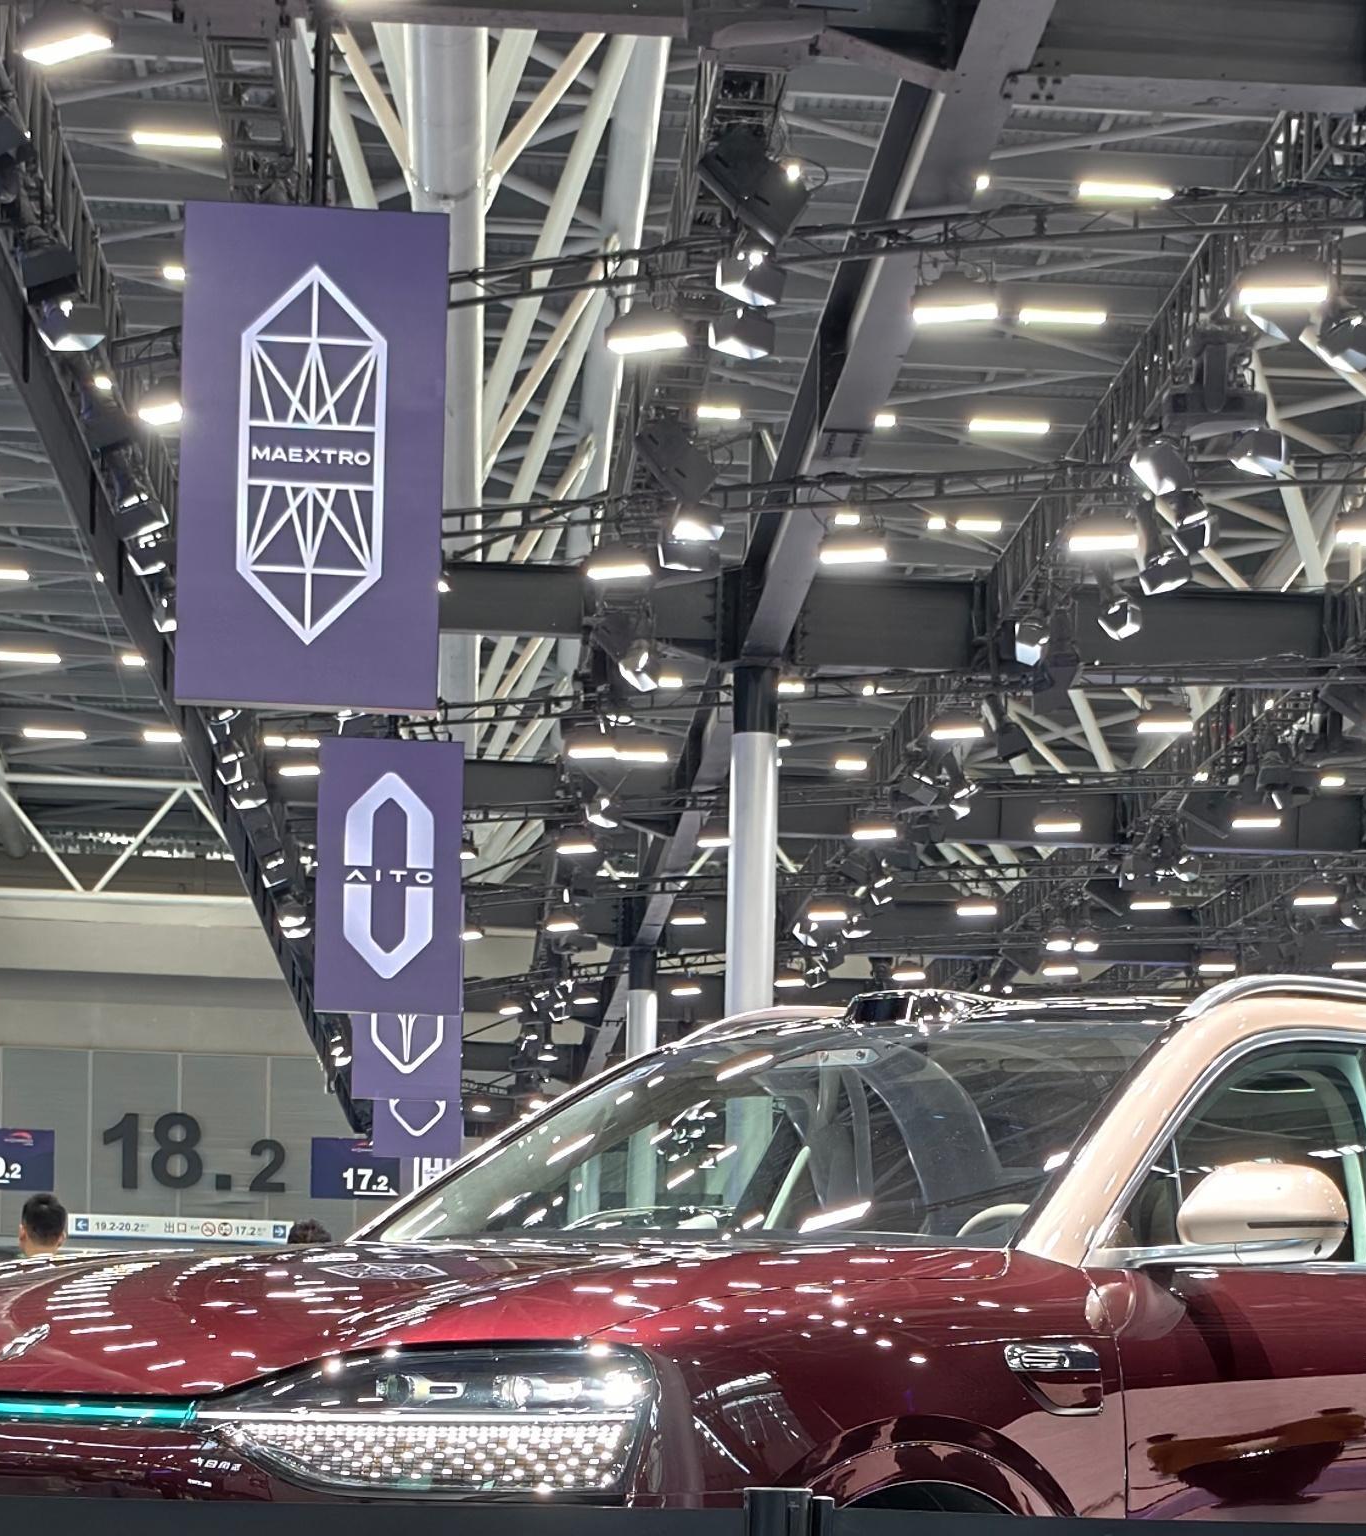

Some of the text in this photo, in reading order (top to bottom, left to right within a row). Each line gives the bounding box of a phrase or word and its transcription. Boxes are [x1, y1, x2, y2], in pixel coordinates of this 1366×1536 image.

[251, 445, 371, 467] MAEXTRO
[345, 868, 434, 885] AITO
[102, 1111, 287, 1194] 18.2
[342, 1167, 389, 1191] 17.2
[94, 1221, 140, 1233] 19.2-20.2
[163, 1222, 187, 1234] 出口
[234, 1226, 257, 1237] 17.2
